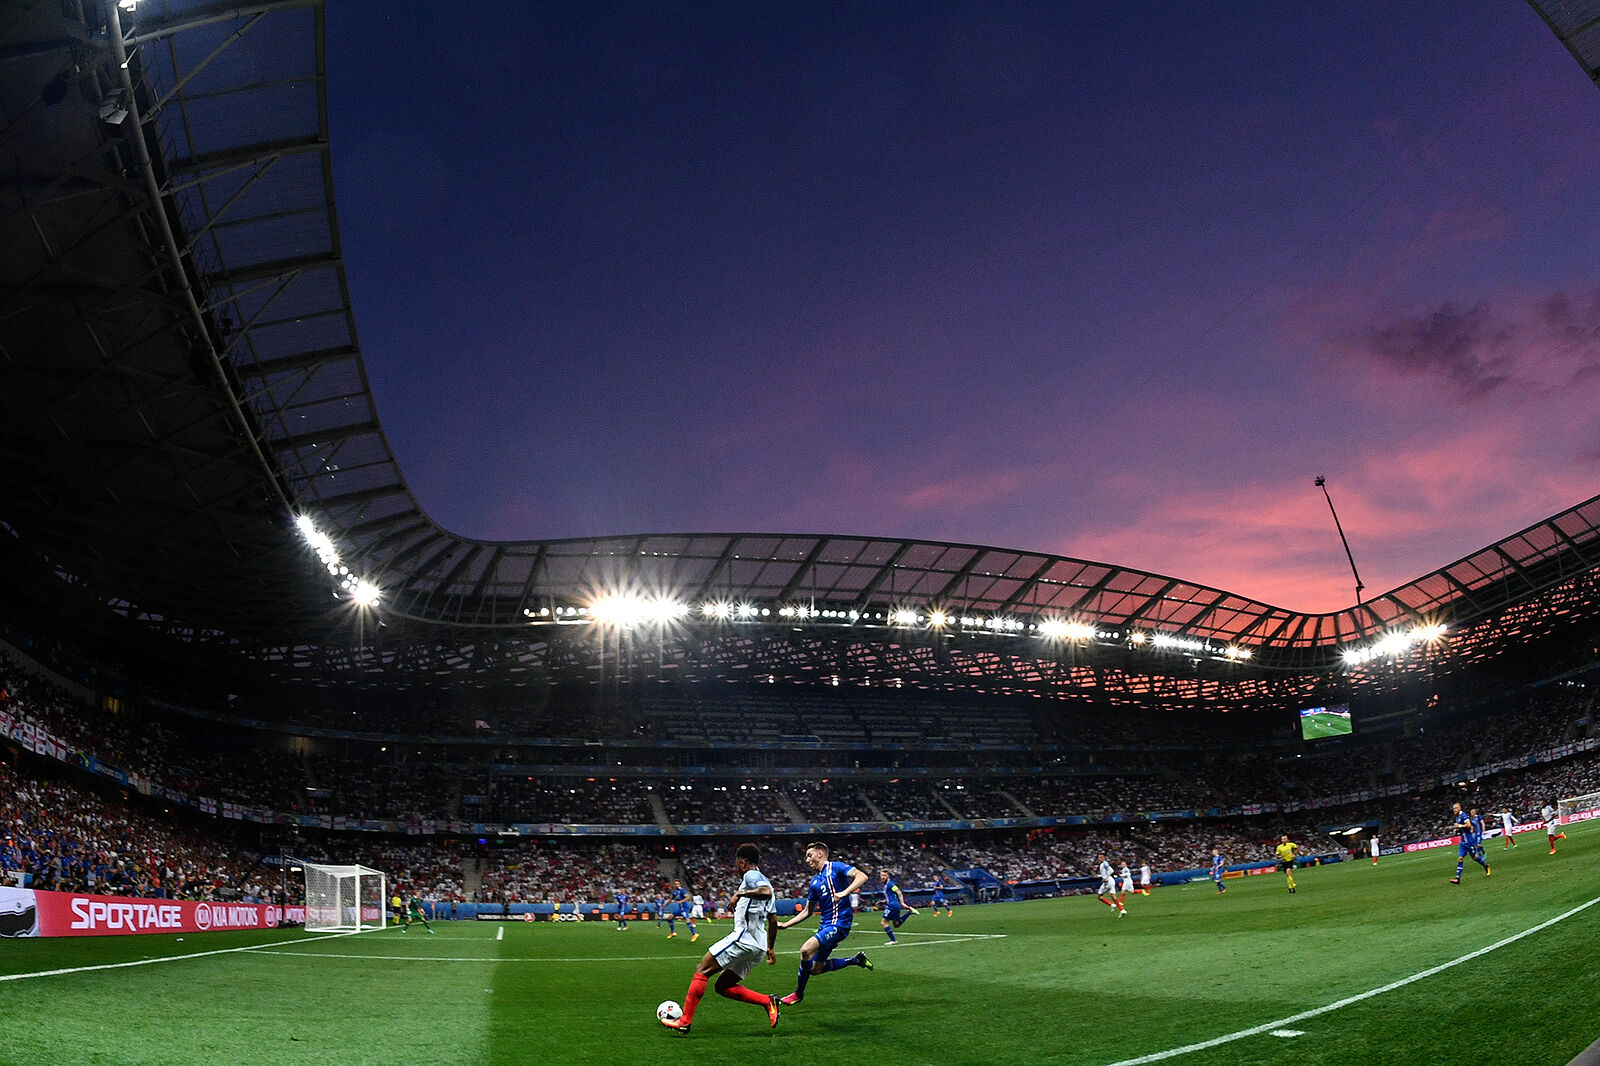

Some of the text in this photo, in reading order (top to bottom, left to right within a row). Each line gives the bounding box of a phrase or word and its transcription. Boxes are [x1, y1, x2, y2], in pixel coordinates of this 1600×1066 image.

[1512, 818, 1561, 834] SPORTE
[1428, 838, 1453, 848] MOTORS
[820, 884, 828, 896] 2
[70, 897, 182, 932] SPORTAGE
[212, 906, 228, 927] KIA
[228, 906, 259, 927] MOTORS
